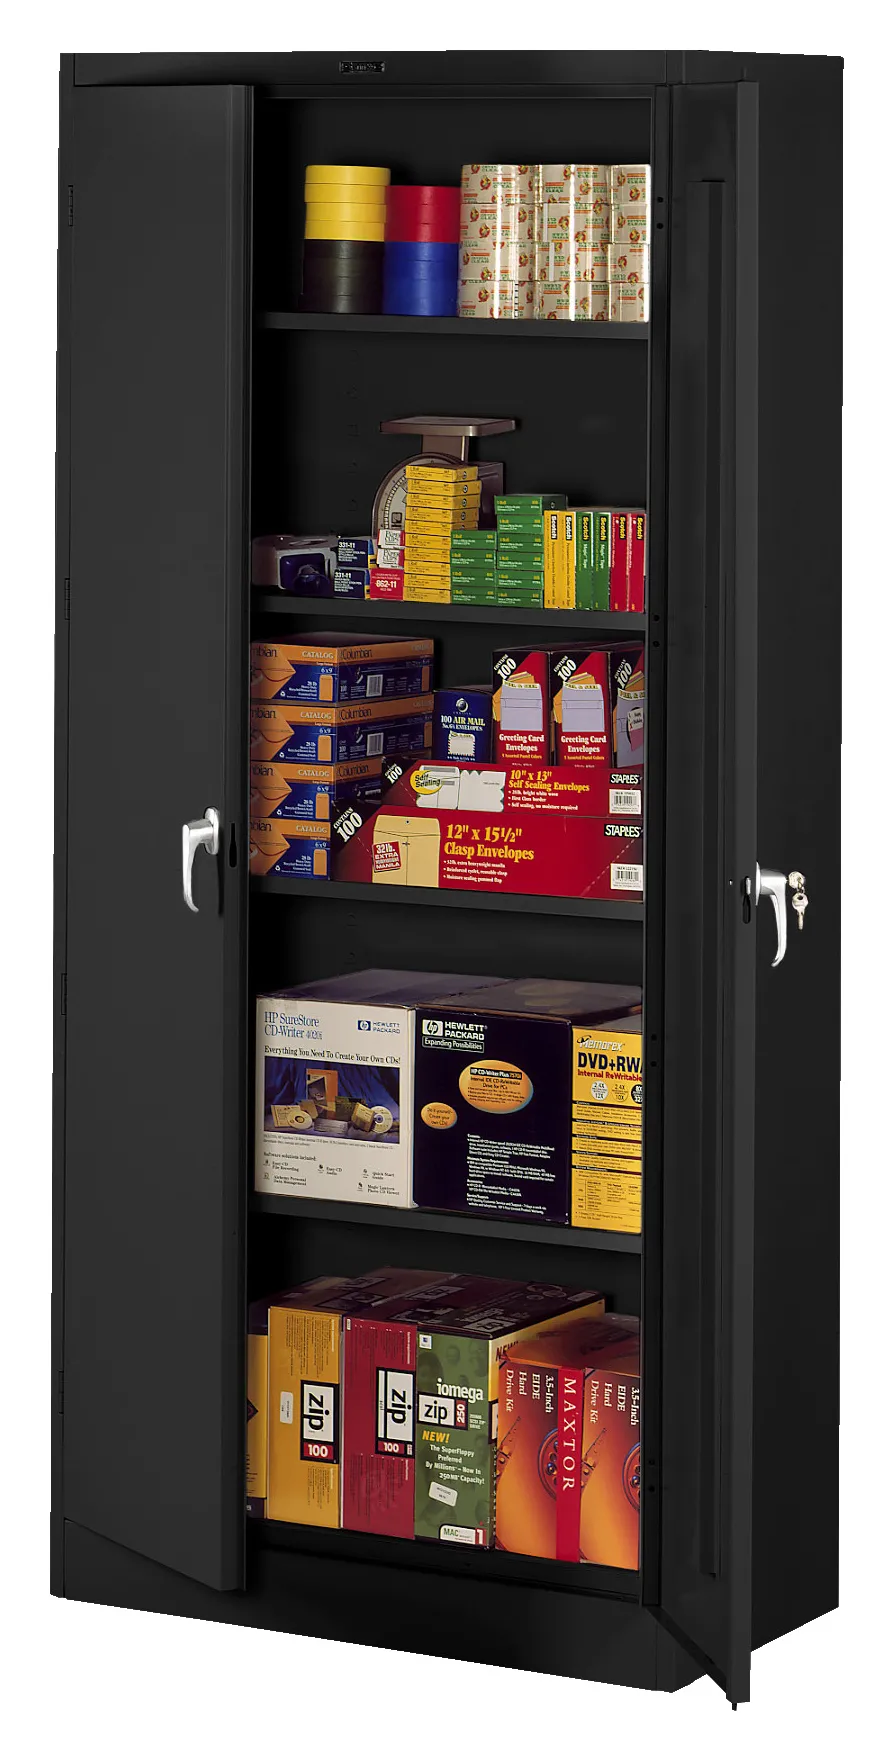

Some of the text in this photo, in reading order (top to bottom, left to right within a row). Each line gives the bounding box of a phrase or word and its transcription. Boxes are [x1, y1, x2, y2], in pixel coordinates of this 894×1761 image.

[343, 649, 372, 659] Columbian
[497, 658, 516, 680] 100
[558, 659, 576, 682] 100
[617, 662, 632, 689] 100
[341, 708, 371, 720] Columbian
[468, 718, 485, 726] MAIL
[499, 734, 527, 744] Greeting
[561, 735, 589, 744] Greeting
[506, 744, 538, 753] Envelopes
[568, 745, 600, 754] Envelopes
[387, 766, 403, 784] 100
[510, 770, 526, 780] 10"
[536, 771, 552, 781] 13"
[611, 774, 639, 784] STAPLES
[415, 779, 440, 787] Sealing
[508, 780, 590, 793] Self Sealing Envelopes
[333, 807, 353, 829] CONTAINS
[337, 812, 363, 842] 100
[446, 824, 469, 839] 12"
[471, 829, 480, 840] x
[605, 824, 640, 838] STAPLES
[376, 844, 395, 854] 32lb.
[444, 842, 535, 863] Clasp Envelopes
[264, 1012, 319, 1027] HP SureStore
[265, 1024, 304, 1038] CD-Writer
[445, 1022, 484, 1032] HEWLETT
[445, 1030, 484, 1040] PACKARD
[424, 1038, 482, 1050] Expanding Possibilities
[577, 1035, 623, 1051] Memorex
[265, 1045, 297, 1056] Everything
[299, 1048, 309, 1056] You
[311, 1049, 324, 1057] Need
[335, 1052, 354, 1060] Create
[386, 1056, 400, 1064] CDs!
[578, 1069, 642, 1081] Internal ReWritable
[436, 1377, 483, 1403] iomega
[519, 1372, 527, 1395] Hard
[532, 1373, 540, 1400] EIDE
[546, 1375, 554, 1413] 3.5-Inch
[604, 1382, 613, 1407] Hard
[617, 1385, 626, 1412] EIDE
[387, 1389, 412, 1424] zip
[590, 1380, 599, 1424] Drive Kit
[630, 1387, 640, 1426] 3.5-Inch
[304, 1393, 329, 1430] zip
[424, 1400, 448, 1424] zip
[457, 1404, 465, 1423] 250
[422, 1430, 450, 1444] NEW!
[562, 1378, 577, 1491] MAXTOR
[308, 1444, 328, 1457] 100
[384, 1442, 399, 1452] 100
[442, 1446, 474, 1457] SuperFloppy
[426, 1461, 433, 1469] By
[438, 1454, 462, 1463] Preferred
[460, 1474, 485, 1485] Capacity!
[444, 1527, 459, 1537] MAC
[476, 1529, 484, 1544] 1
